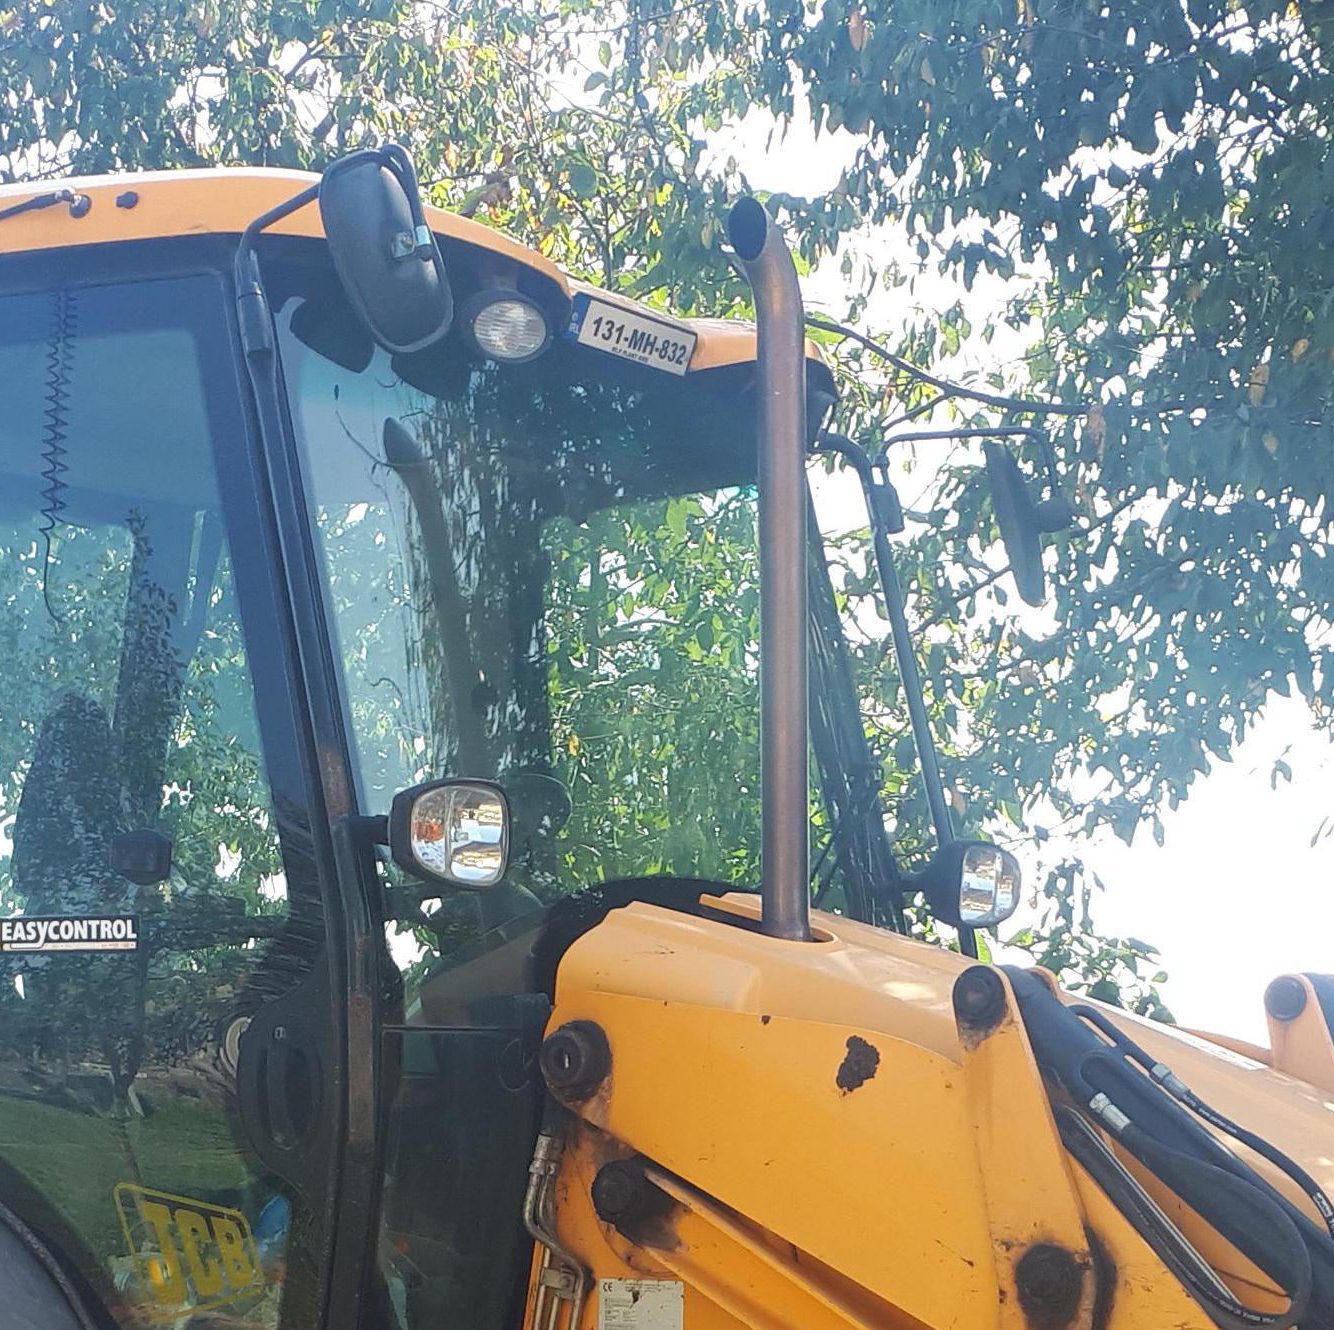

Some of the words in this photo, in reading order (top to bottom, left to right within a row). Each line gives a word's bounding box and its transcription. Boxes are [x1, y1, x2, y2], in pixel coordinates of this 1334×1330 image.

[593, 316, 687, 366] 131-MH-832
[2, 919, 136, 945] EASYCONTROL
[141, 1200, 253, 1305] JCB
